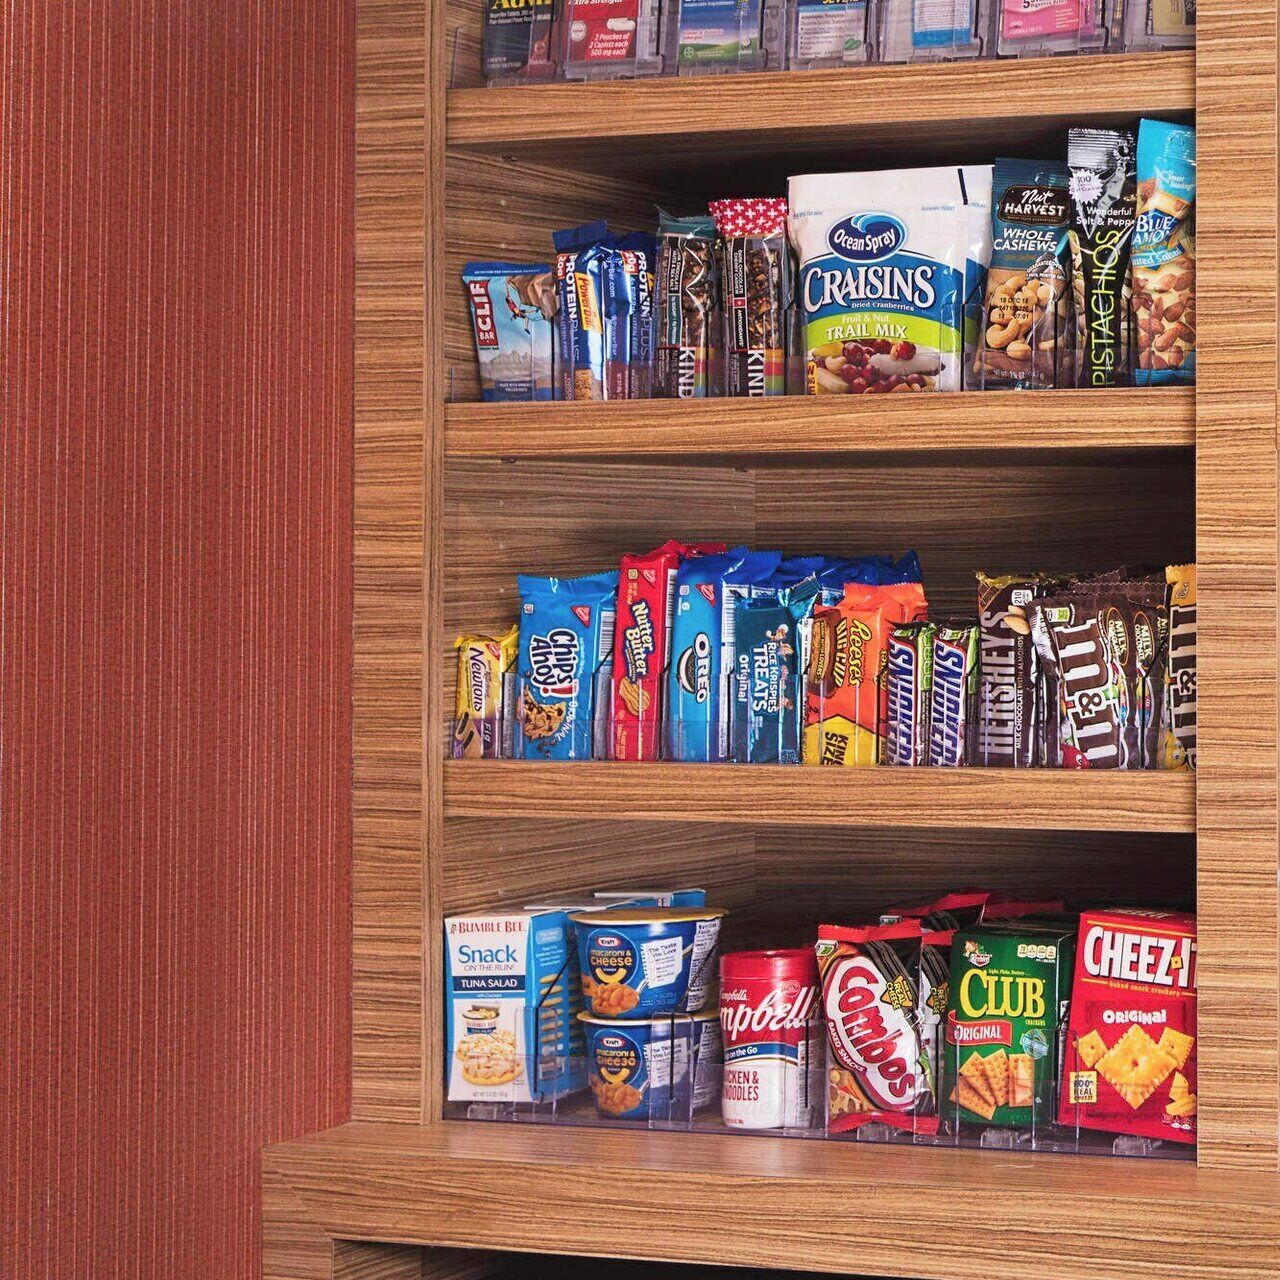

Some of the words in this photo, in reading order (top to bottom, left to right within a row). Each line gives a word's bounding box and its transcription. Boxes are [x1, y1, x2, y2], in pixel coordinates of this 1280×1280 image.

[1005, 202, 1065, 217] HARVEST
[1021, 188, 1054, 205] Nut
[1086, 206, 1132, 216] Wonderful
[833, 229, 865, 251] Ocean
[866, 229, 896, 253] Spray
[1003, 228, 1055, 241] WHOLE
[1136, 215, 1173, 232] BLUE
[993, 240, 1058, 251] CASHEWS
[565, 253, 579, 319] PROTEIN
[636, 252, 654, 317] PROTEIN
[803, 265, 936, 313] CRAISINS
[469, 282, 492, 331] CLIF
[580, 277, 598, 330] PowerBar
[842, 315, 861, 323] Fruit
[874, 314, 889, 322] Nut
[852, 301, 871, 309] Dried
[872, 301, 914, 312] Cranberries
[1092, 230, 1119, 385] PISTACHIOS
[480, 333, 495, 341] BAR
[826, 325, 869, 339] TRAIL
[876, 325, 909, 339] MIX
[679, 347, 696, 398] KIND
[633, 602, 653, 654] Nutter
[549, 630, 578, 685] Chips
[626, 627, 647, 675] Butter
[694, 634, 710, 704] OREO
[768, 642, 776, 660] RICE
[470, 647, 484, 712] Newtons
[737, 654, 749, 702] Original
[754, 647, 768, 712] TREATS
[768, 660, 778, 713] KRISPIES
[980, 611, 1015, 754] HERSHEY'S
[458, 921, 502, 933] BUMBLE
[505, 921, 524, 932] BEE
[458, 945, 518, 963] Snack
[591, 949, 624, 958] macaroni
[461, 979, 487, 988] TUNA
[488, 978, 517, 987] SALAD
[959, 969, 1045, 1018] CLUB
[1109, 981, 1129, 989] baked
[1131, 983, 1150, 991] snack
[1151, 986, 1180, 997] crackers
[828, 1022, 841, 1049] BAKED
[838, 1048, 865, 1073] SNACKS
[838, 966, 915, 1098] Combos
[954, 1026, 1001, 1041] ORIGINAL
[1073, 1087, 1093, 1095] REAL
